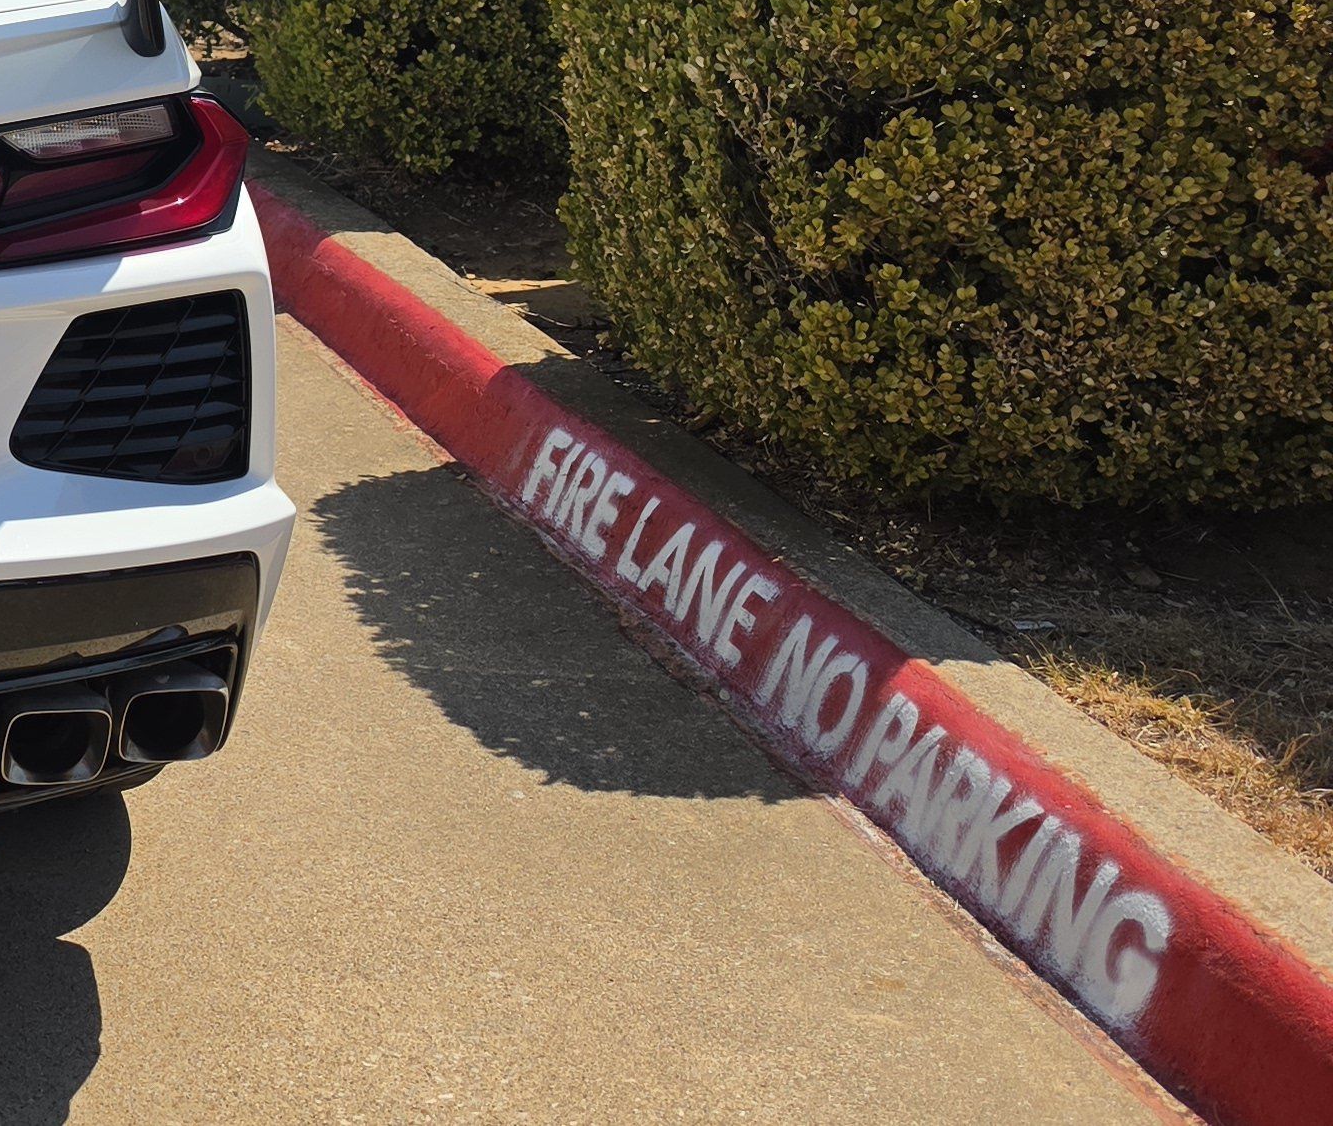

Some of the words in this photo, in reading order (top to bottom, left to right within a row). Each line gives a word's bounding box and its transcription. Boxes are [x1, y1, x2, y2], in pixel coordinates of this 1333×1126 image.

[520, 426, 636, 560] FIRE
[615, 495, 781, 669] LANE
[752, 614, 869, 761] NO
[843, 692, 1171, 1028] PARKING
